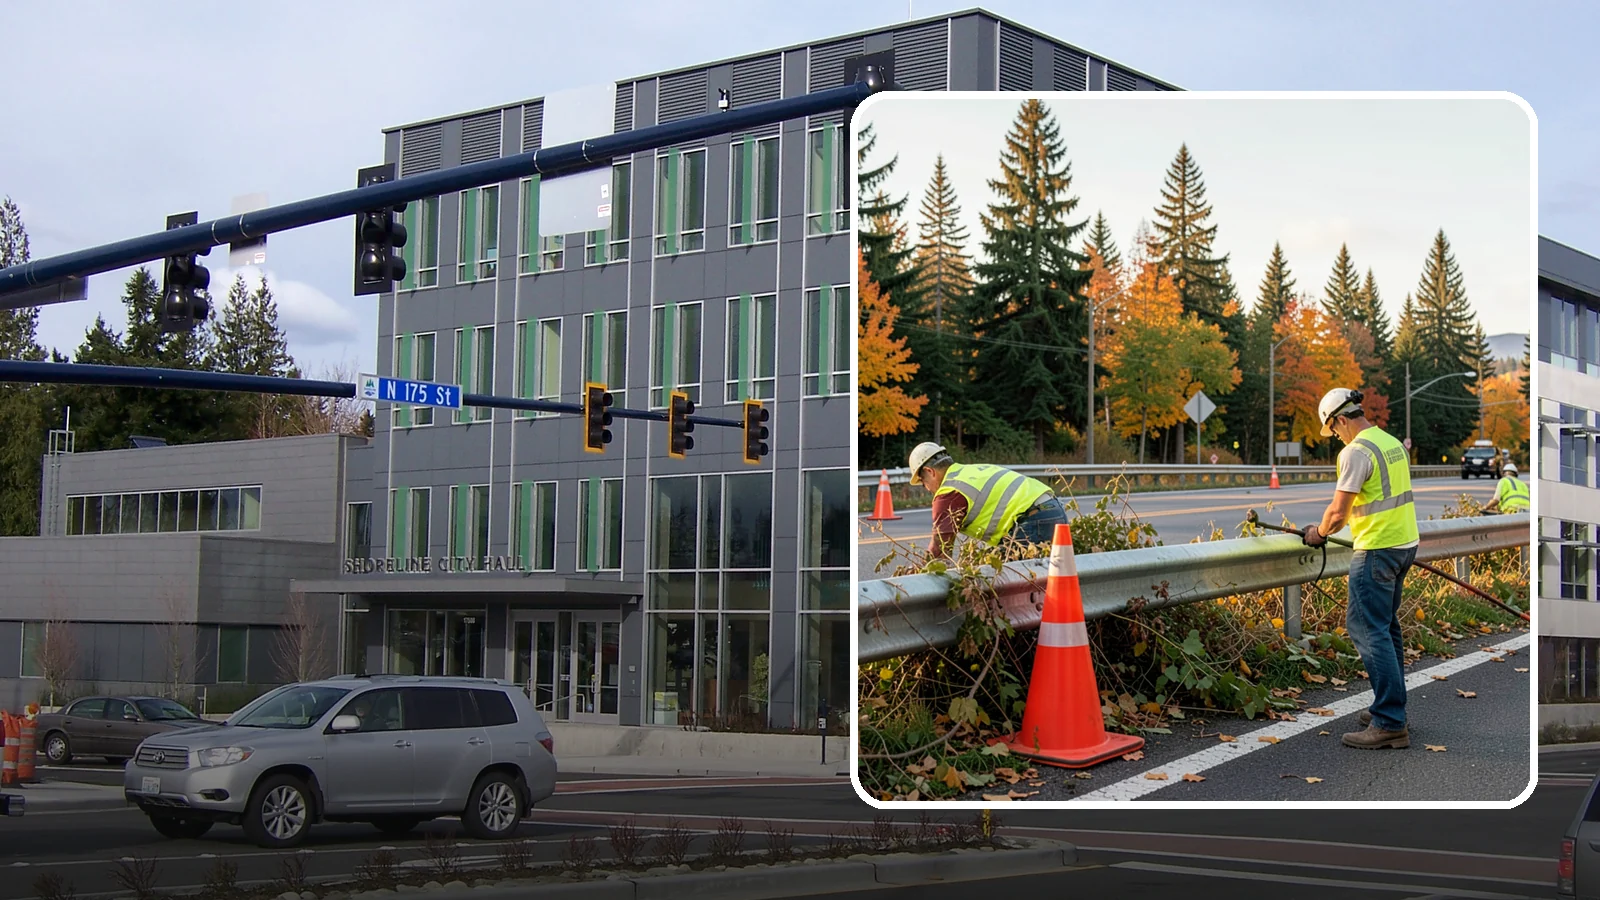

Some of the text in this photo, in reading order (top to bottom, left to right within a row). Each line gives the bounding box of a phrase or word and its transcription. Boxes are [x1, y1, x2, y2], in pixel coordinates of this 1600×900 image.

[387, 380, 451, 406] N 175 St
[344, 555, 526, 574] SHORELINE CITY HALL
